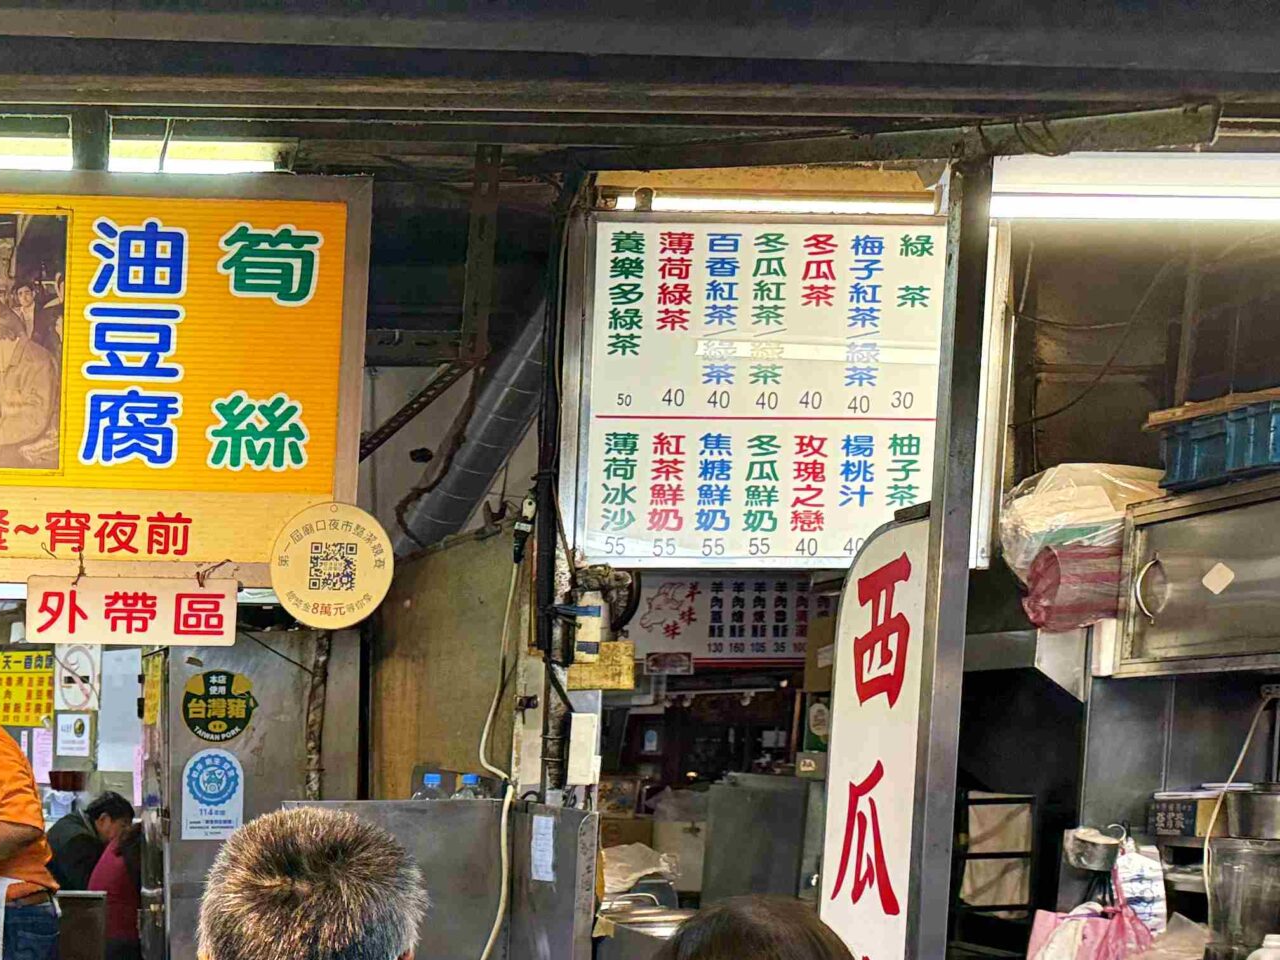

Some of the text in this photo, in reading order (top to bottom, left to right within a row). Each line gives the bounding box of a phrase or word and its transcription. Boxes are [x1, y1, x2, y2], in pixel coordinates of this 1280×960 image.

[656, 231, 695, 331] 薄荷綠茶
[801, 233, 838, 307] 冬瓜茶
[896, 234, 935, 308] 綠茶
[607, 230, 646, 356] 養樂多綠茶
[83, 219, 185, 466] 油豆腐
[210, 226, 322, 469] 筍絲
[616, 393, 632, 407] 50
[662, 388, 685, 407] 40
[707, 391, 730, 409] 40
[756, 391, 778, 410] 40
[799, 391, 822, 409] 40
[847, 395, 870, 414] 40
[891, 391, 913, 409] 30
[839, 434, 874, 508] 楊桃汁
[885, 433, 921, 507] 柚子茶
[600, 432, 639, 532] 薄荷冰沙
[647, 432, 686, 532] 紅茶鮮奶
[695, 432, 733, 533] 焦糖鮮奶
[743, 435, 782, 533] 冬瓜鮮奶
[789, 434, 828, 533] 玫瑰之戀
[605, 536, 626, 556] 55
[653, 538, 676, 557] 55
[702, 537, 725, 556] 55
[749, 536, 771, 555] 55
[795, 538, 818, 556] 40
[36, 588, 226, 638] 外帶區
[773, 642, 786, 653] 35
[187, 697, 247, 720] 台灣豬
[193, 725, 241, 742] TAIWAN PORK
